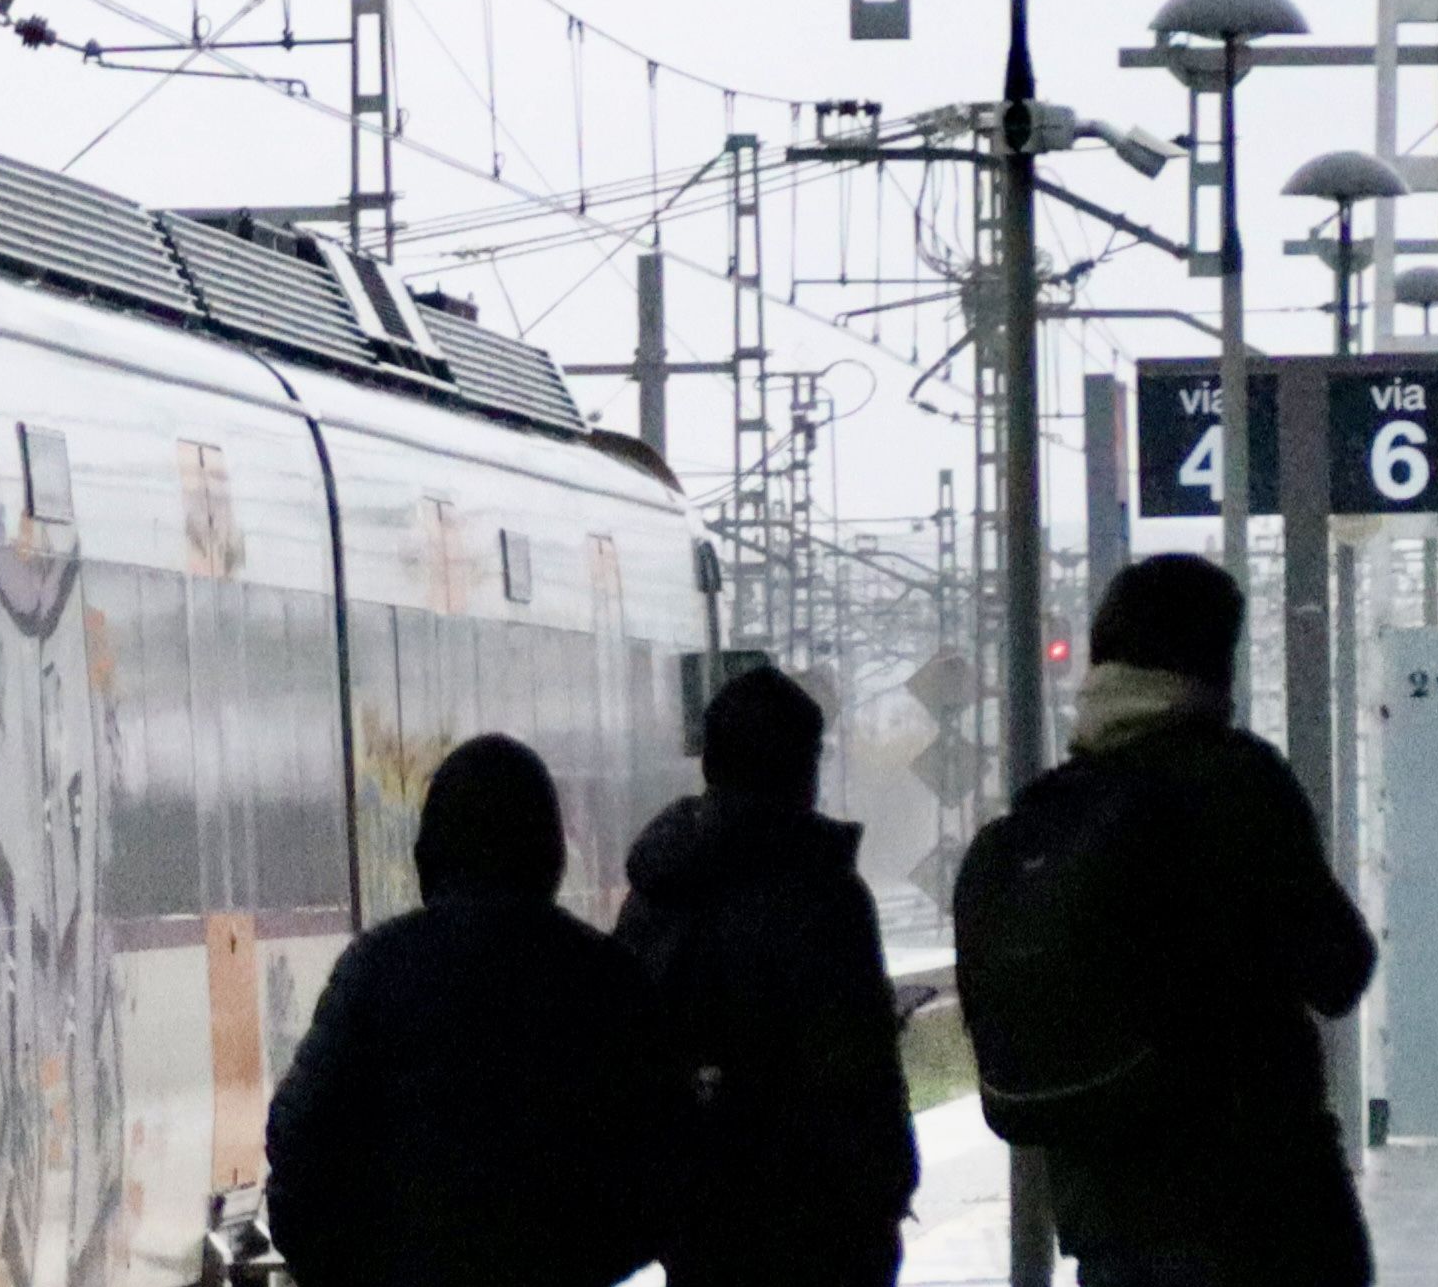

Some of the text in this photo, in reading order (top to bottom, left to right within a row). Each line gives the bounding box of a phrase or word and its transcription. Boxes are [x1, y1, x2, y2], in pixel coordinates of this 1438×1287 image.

[1370, 376, 1427, 412] via
[1178, 424, 1224, 502] 4
[1371, 419, 1430, 502] 6
